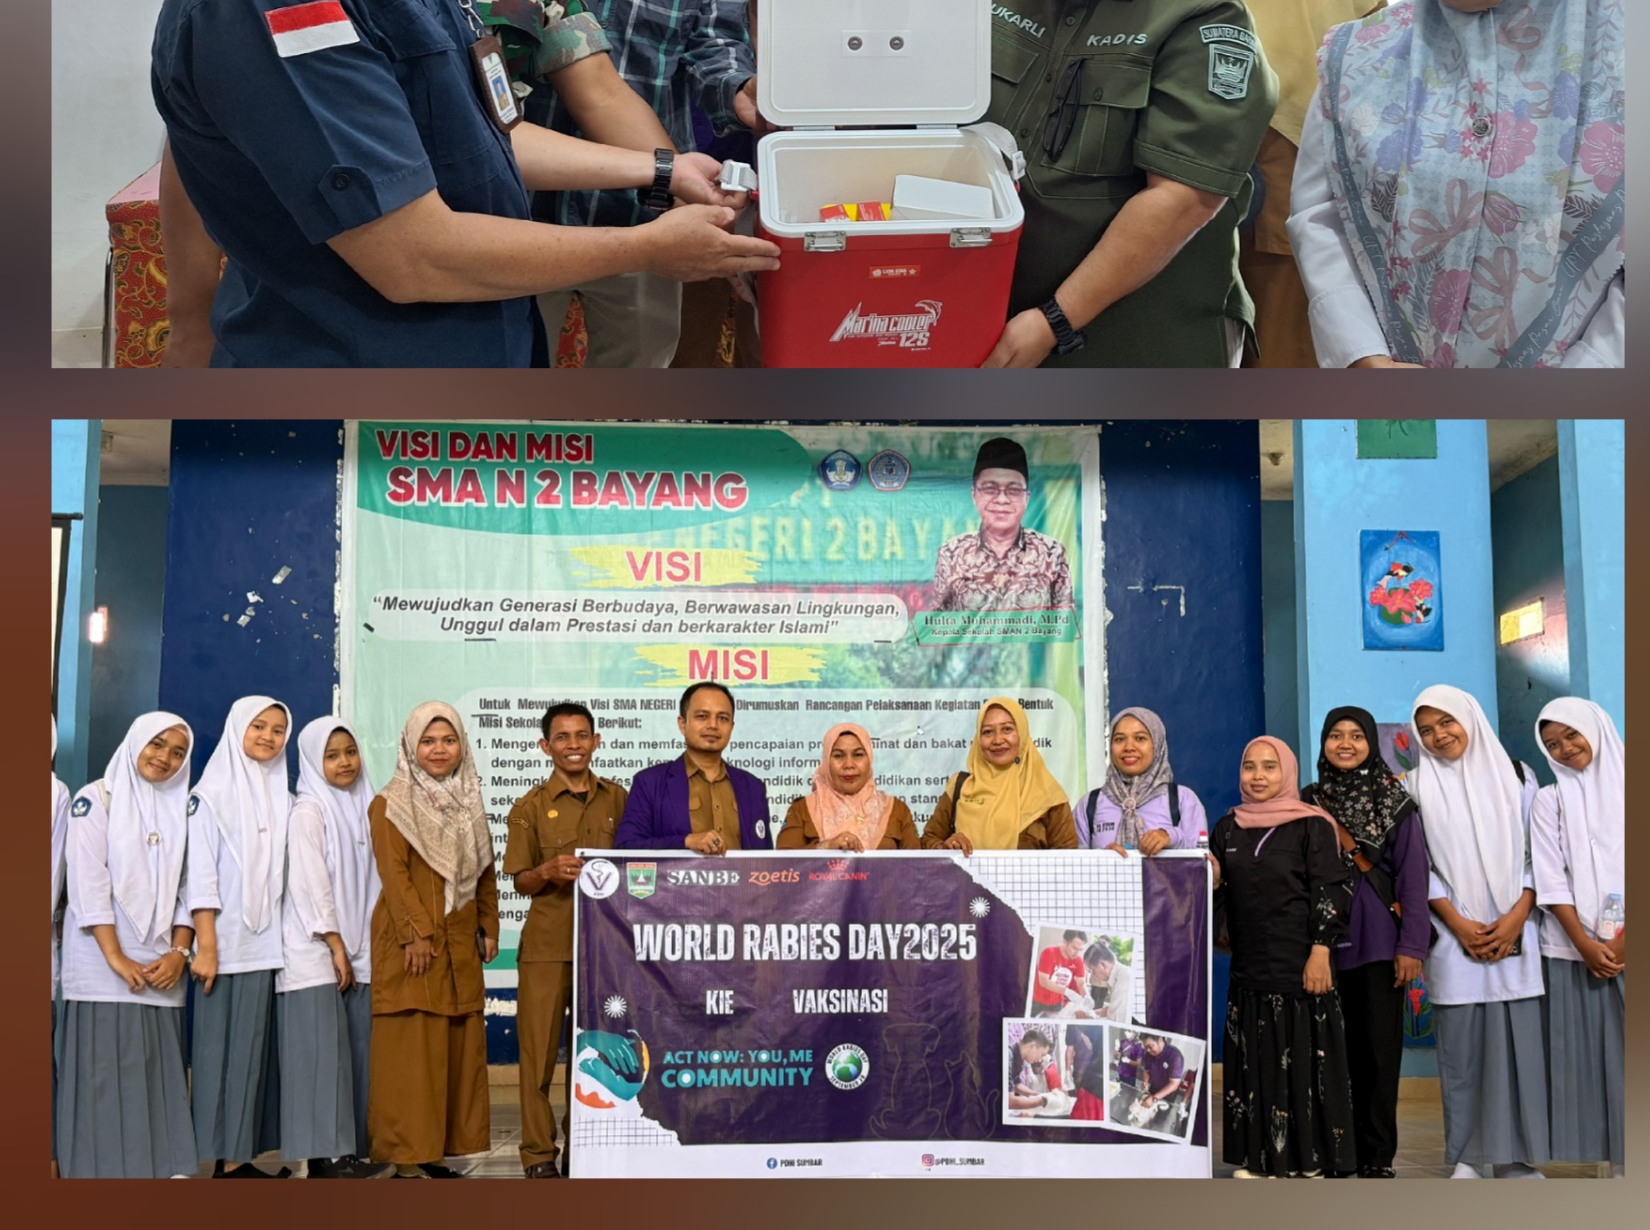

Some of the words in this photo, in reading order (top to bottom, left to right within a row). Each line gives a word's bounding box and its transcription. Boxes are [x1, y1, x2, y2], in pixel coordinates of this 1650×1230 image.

[1086, 33, 1149, 47] KADIS
[376, 429, 440, 460] VISI
[448, 431, 517, 462] DAN
[526, 432, 594, 463] MISI
[386, 467, 489, 506] SMA
[495, 468, 526, 507] N
[535, 470, 562, 506] 2
[571, 472, 748, 510] BAYANG
[626, 551, 701, 582] VISI
[499, 597, 577, 613] Generasi
[582, 598, 680, 616] Berbudaya,
[685, 600, 792, 615] Berwawasan
[797, 601, 899, 619] Lingkungan,
[440, 617, 503, 635] Unggul
[509, 618, 560, 633] dalam
[566, 618, 637, 633] Prestasi
[642, 619, 673, 633] dan
[679, 619, 776, 634] berkarakter
[688, 649, 769, 680] MISI
[479, 698, 511, 710] Untuk
[613, 699, 636, 710] SMA
[640, 699, 676, 710] NEGERI
[736, 699, 799, 711] Dirumuskan
[806, 700, 862, 712] Rancangan
[865, 699, 932, 711] Pelaksanaan
[935, 699, 979, 712] Kegiatan
[598, 717, 642, 729] Berikut:
[730, 739, 804, 751] pencapaian
[932, 738, 967, 749] bakat
[667, 870, 740, 886] SANBE
[749, 868, 800, 886] zoetis
[809, 872, 838, 881] ROYAL
[839, 872, 868, 881] CANIN
[633, 923, 735, 962] WORLD
[743, 923, 841, 961] RABIES
[706, 990, 734, 1014] KIE
[793, 989, 888, 1013] VAKSINASI
[663, 1051, 694, 1064] ACT
[697, 1050, 744, 1064] NOW:
[748, 1050, 787, 1066] YOU,
[790, 1050, 813, 1063] ME
[661, 1068, 813, 1088] COMMUNITY
[796, 1159, 823, 1167] SUMBAR
